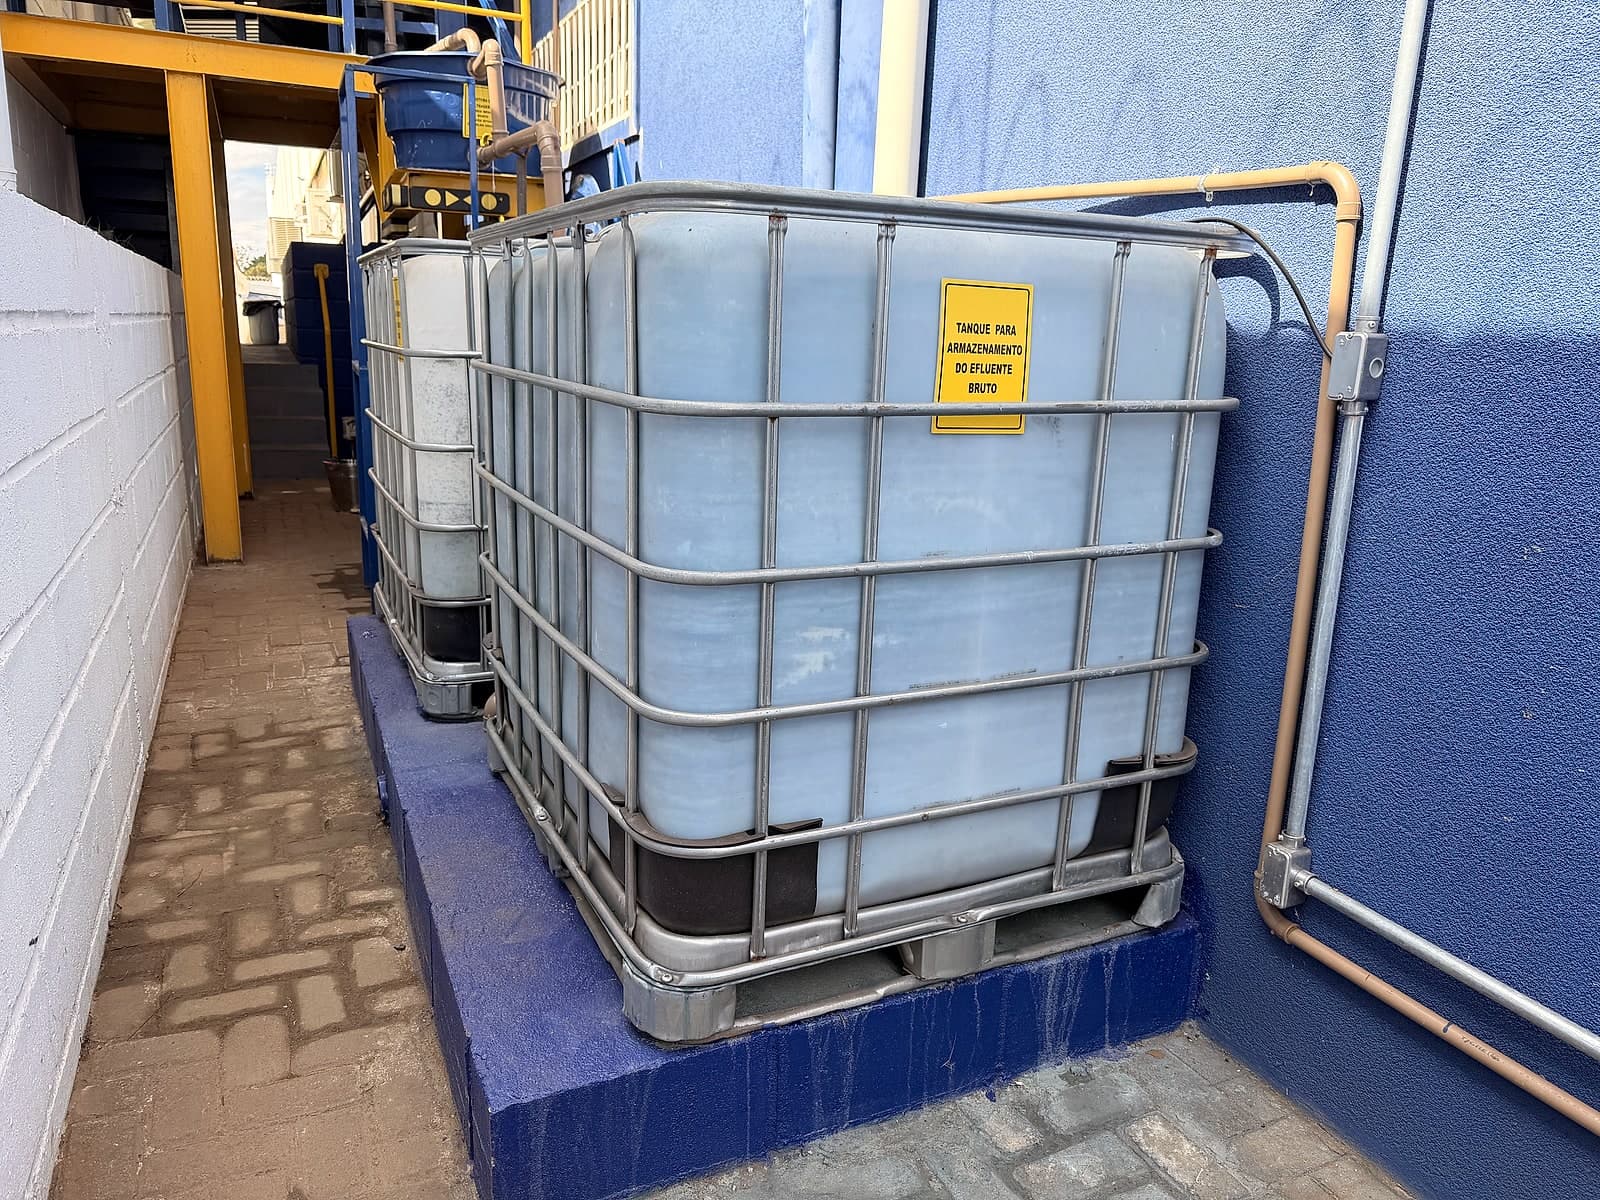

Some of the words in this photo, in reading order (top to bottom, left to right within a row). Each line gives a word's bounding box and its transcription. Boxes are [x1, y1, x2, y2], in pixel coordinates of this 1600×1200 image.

[956, 322, 991, 335] TANQUE
[995, 324, 1017, 336] PARA
[947, 342, 1023, 356] ARMAZENAMENTO
[955, 362, 968, 374] DO
[969, 363, 1013, 375] EFLUENTE
[968, 383, 998, 394] BRUTO
